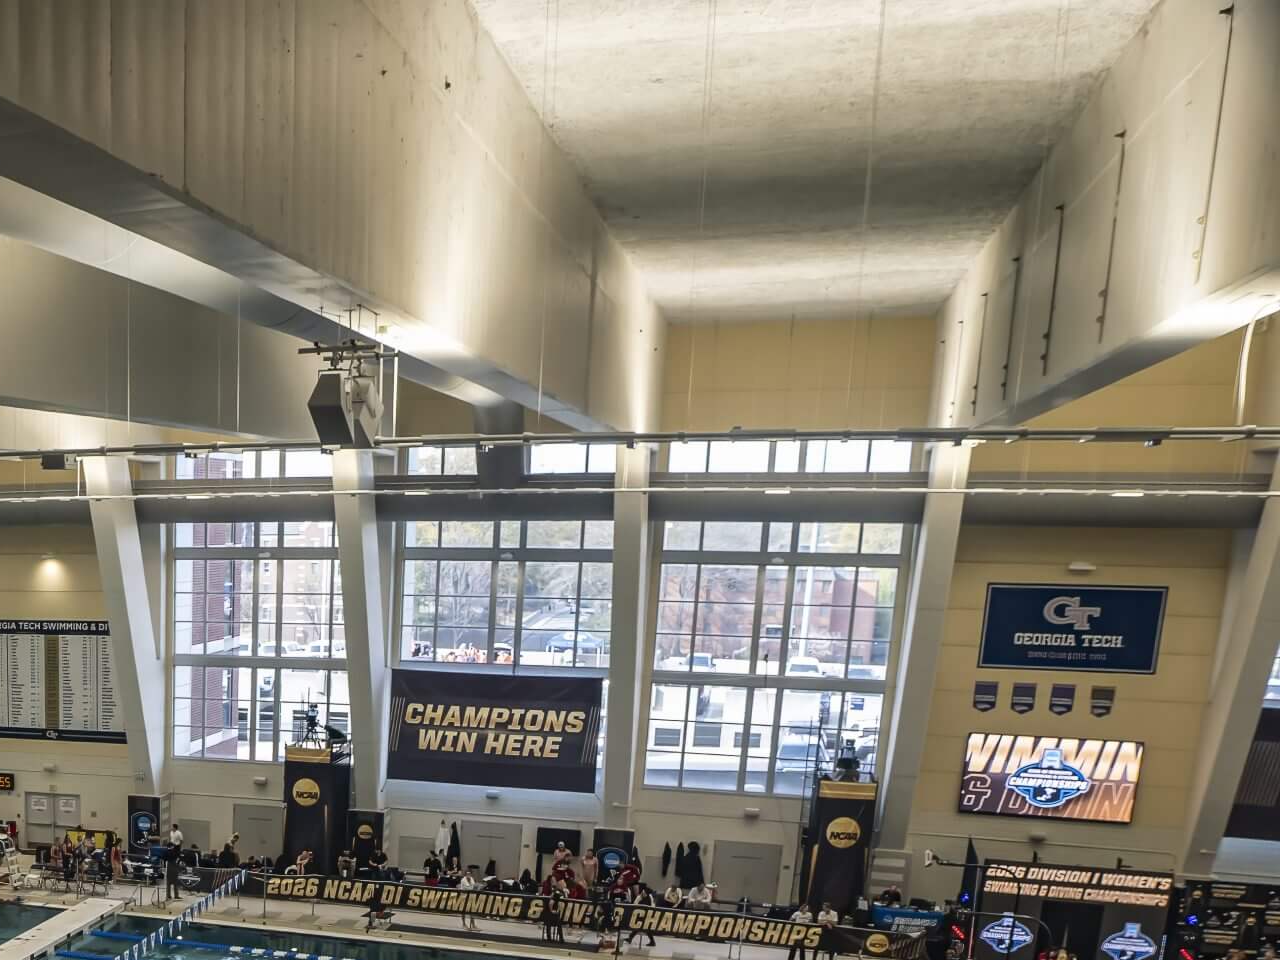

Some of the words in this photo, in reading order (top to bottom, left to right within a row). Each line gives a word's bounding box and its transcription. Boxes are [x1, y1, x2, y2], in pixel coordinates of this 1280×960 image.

[18, 621, 41, 631] TECH
[42, 622, 89, 632] SWIMMING
[1043, 595, 1102, 631] GT
[1013, 633, 1076, 647] GEORGIA
[1081, 635, 1124, 648] TECH
[405, 702, 586, 733] CHAMPIONS
[419, 729, 478, 753] WIN
[484, 733, 562, 758] HERE
[986, 864, 1026, 879] 2026
[1026, 867, 1091, 885] DIVISION
[1091, 872, 1100, 885] I
[1101, 873, 1172, 890] WOMEN'S
[983, 880, 1038, 897] SWIMMING
[1038, 886, 1047, 897] &
[1047, 885, 1083, 900] DIVING
[1083, 889, 1169, 907] CHAMPIONSHIPS
[267, 877, 319, 898] 2026
[381, 885, 400, 905] DI
[407, 890, 523, 918] SWIMMING
[527, 899, 544, 919] &
[628, 904, 823, 948] CHAMPIONSHIPS
